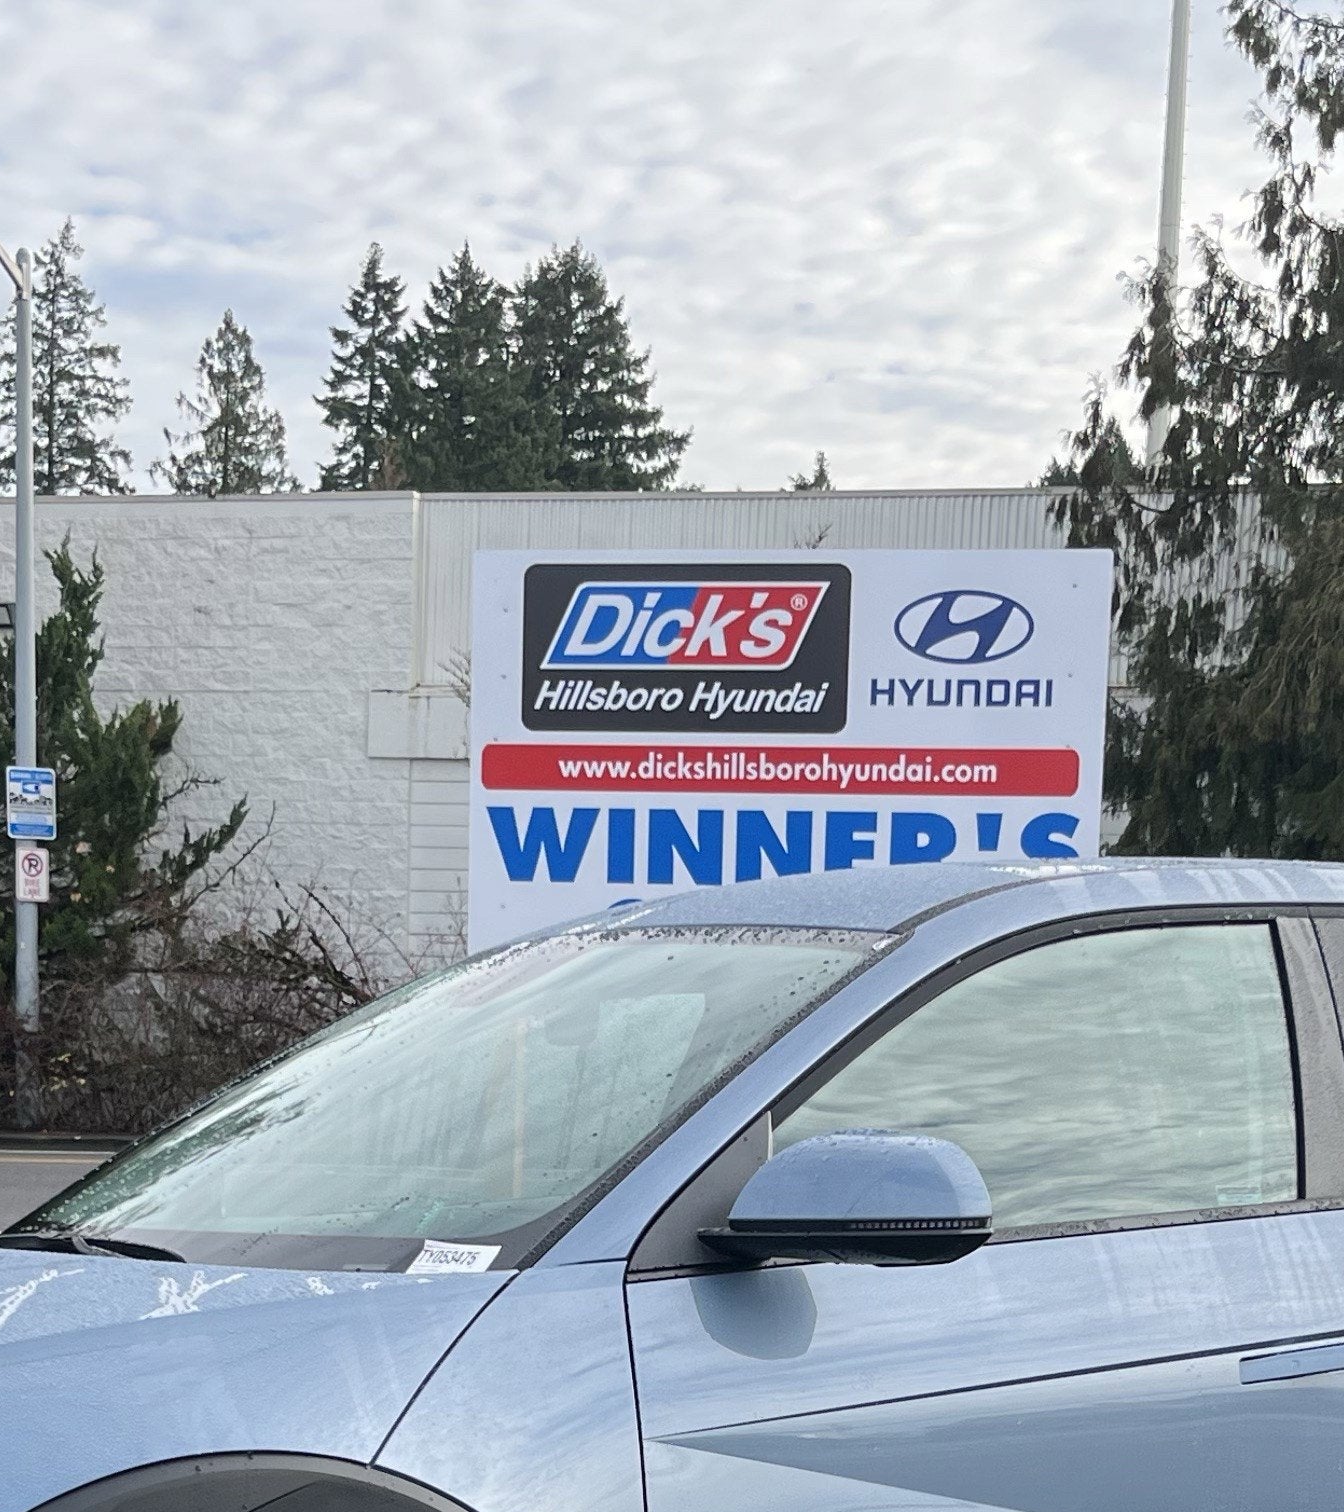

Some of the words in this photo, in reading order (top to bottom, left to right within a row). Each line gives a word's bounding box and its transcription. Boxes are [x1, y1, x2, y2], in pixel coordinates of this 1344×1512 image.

[534, 680, 683, 712] Hillsboro
[689, 681, 829, 721] Hyundai
[870, 678, 1054, 707] HYUNDAI
[558, 751, 998, 790] www.dickshillsborohyundai.com
